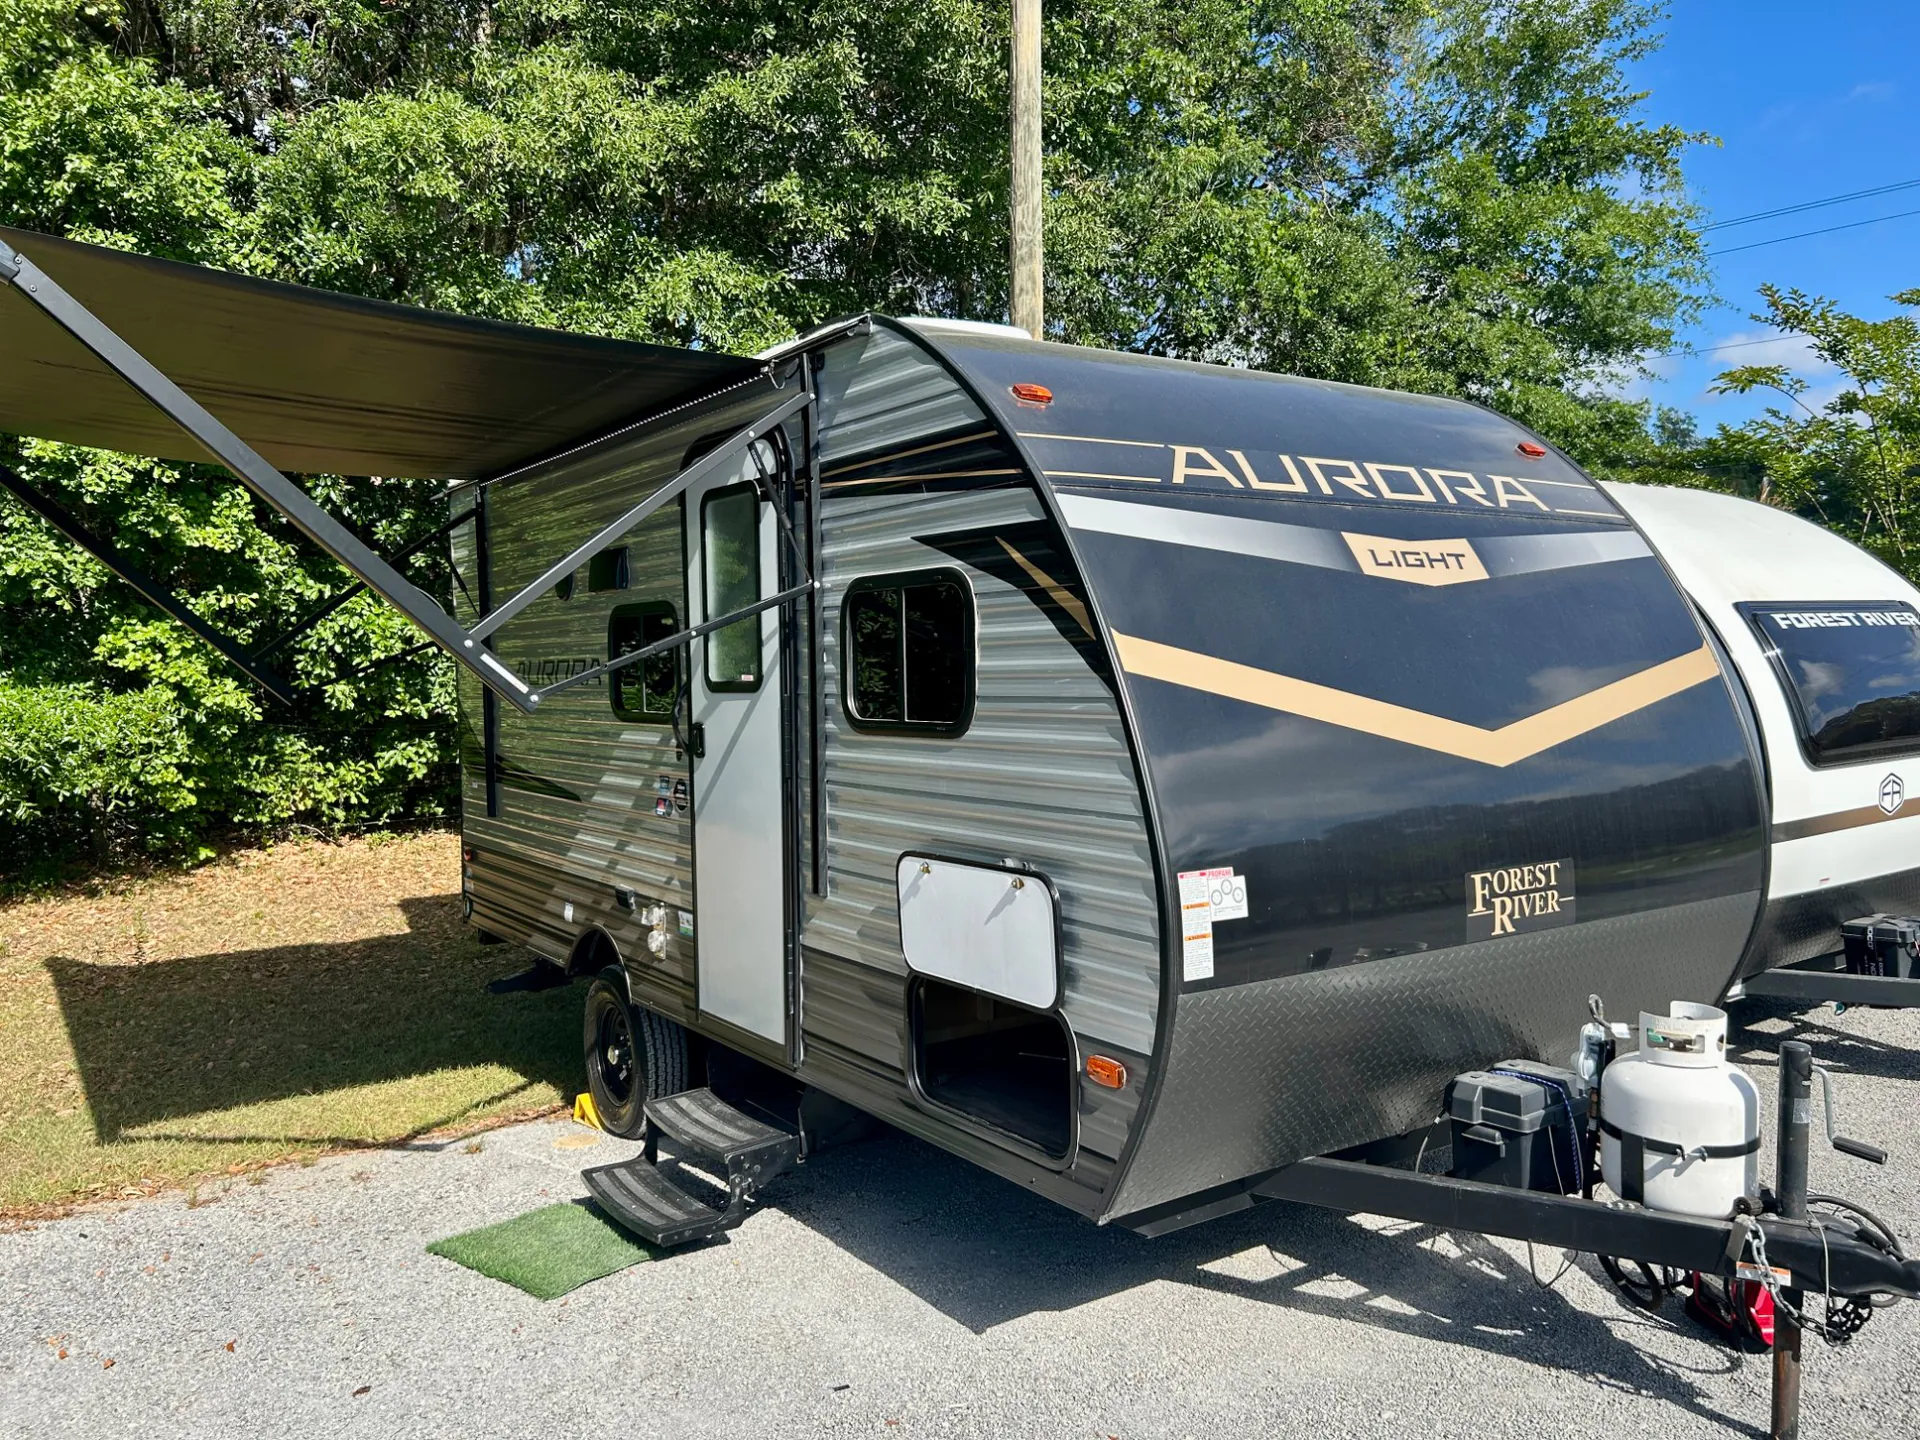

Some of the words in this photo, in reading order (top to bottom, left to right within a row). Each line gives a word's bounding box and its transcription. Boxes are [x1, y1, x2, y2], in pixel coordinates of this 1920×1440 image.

[1168, 444, 1550, 511] AURORA
[1368, 549, 1466, 570] LIGHT
[1770, 612, 1861, 630] FOREST
[1860, 612, 1920, 626] RIVER
[517, 658, 601, 686] AURORA
